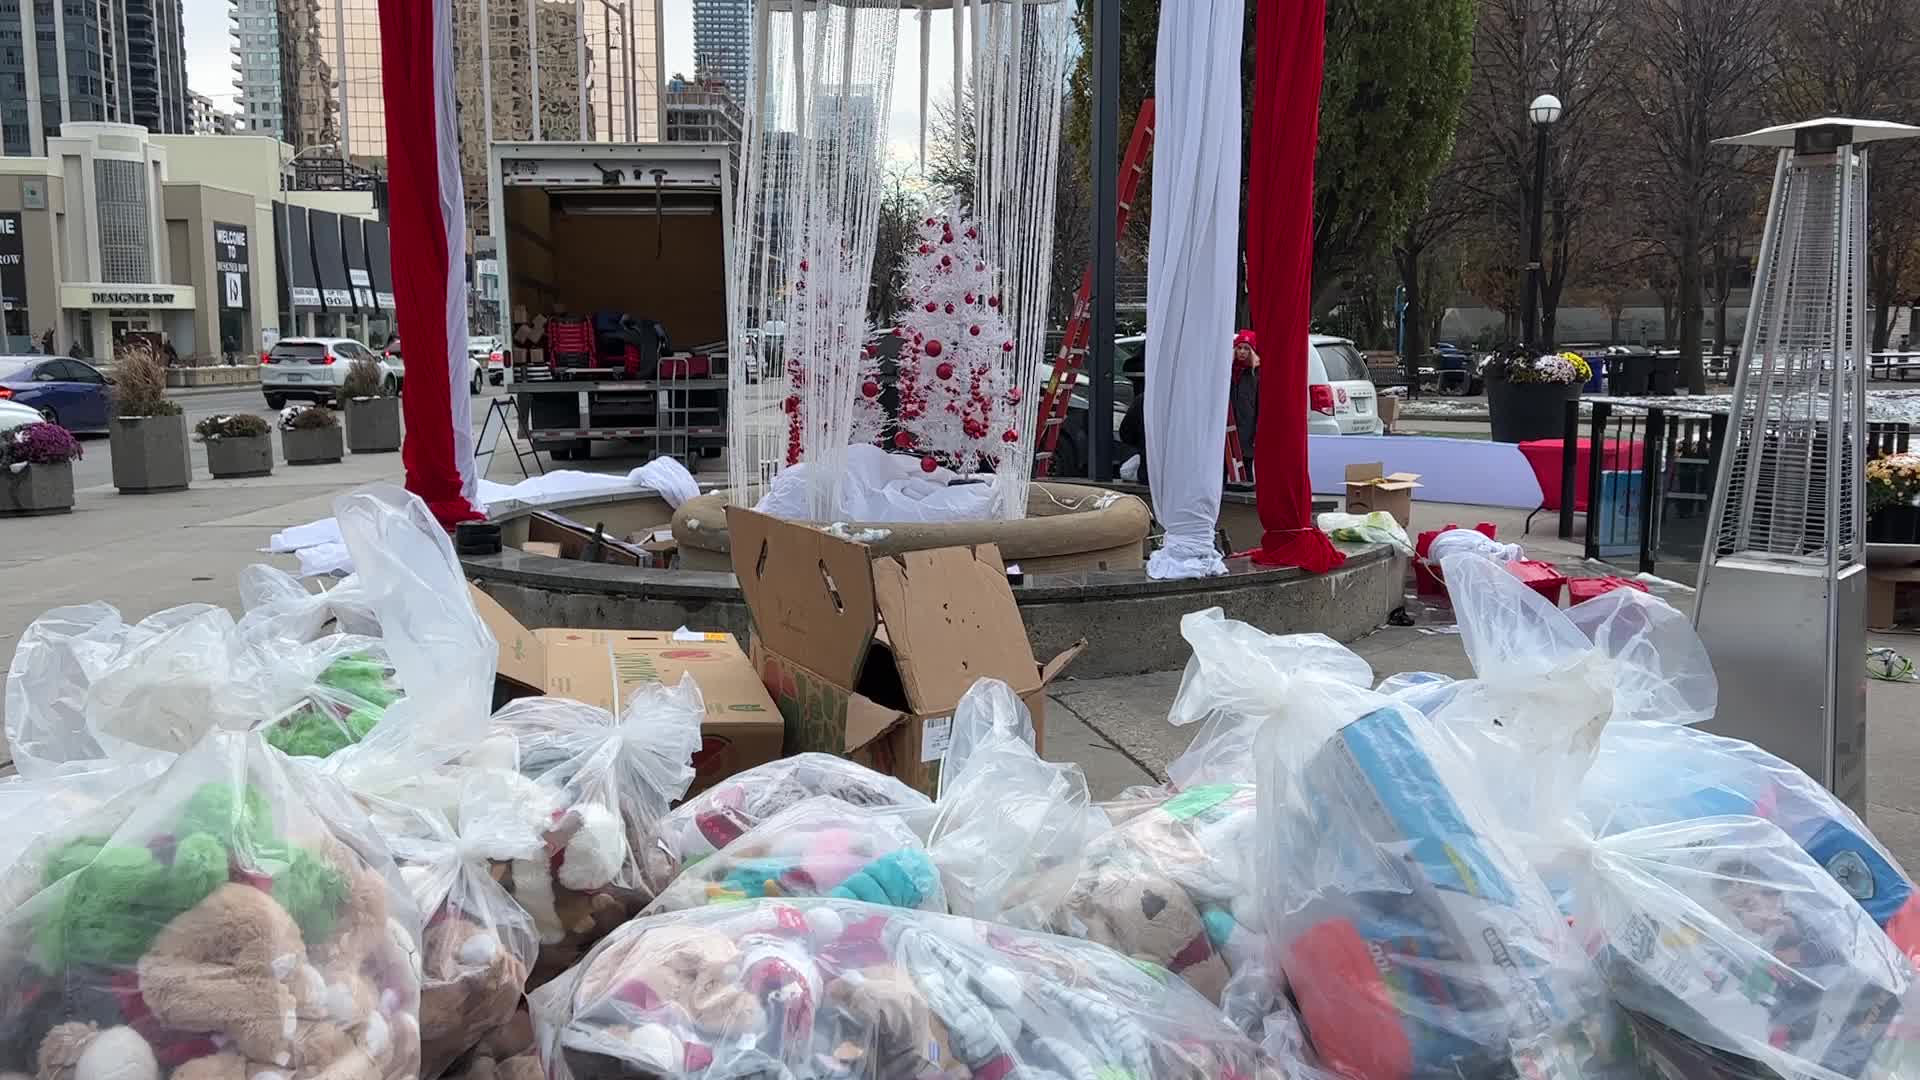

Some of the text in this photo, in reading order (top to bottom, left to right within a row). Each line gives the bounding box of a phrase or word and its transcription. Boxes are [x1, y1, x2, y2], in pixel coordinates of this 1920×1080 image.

[216, 229, 246, 246] WELCOME
[227, 245, 237, 259] TO
[92, 292, 175, 304] DESIGNER ROW
